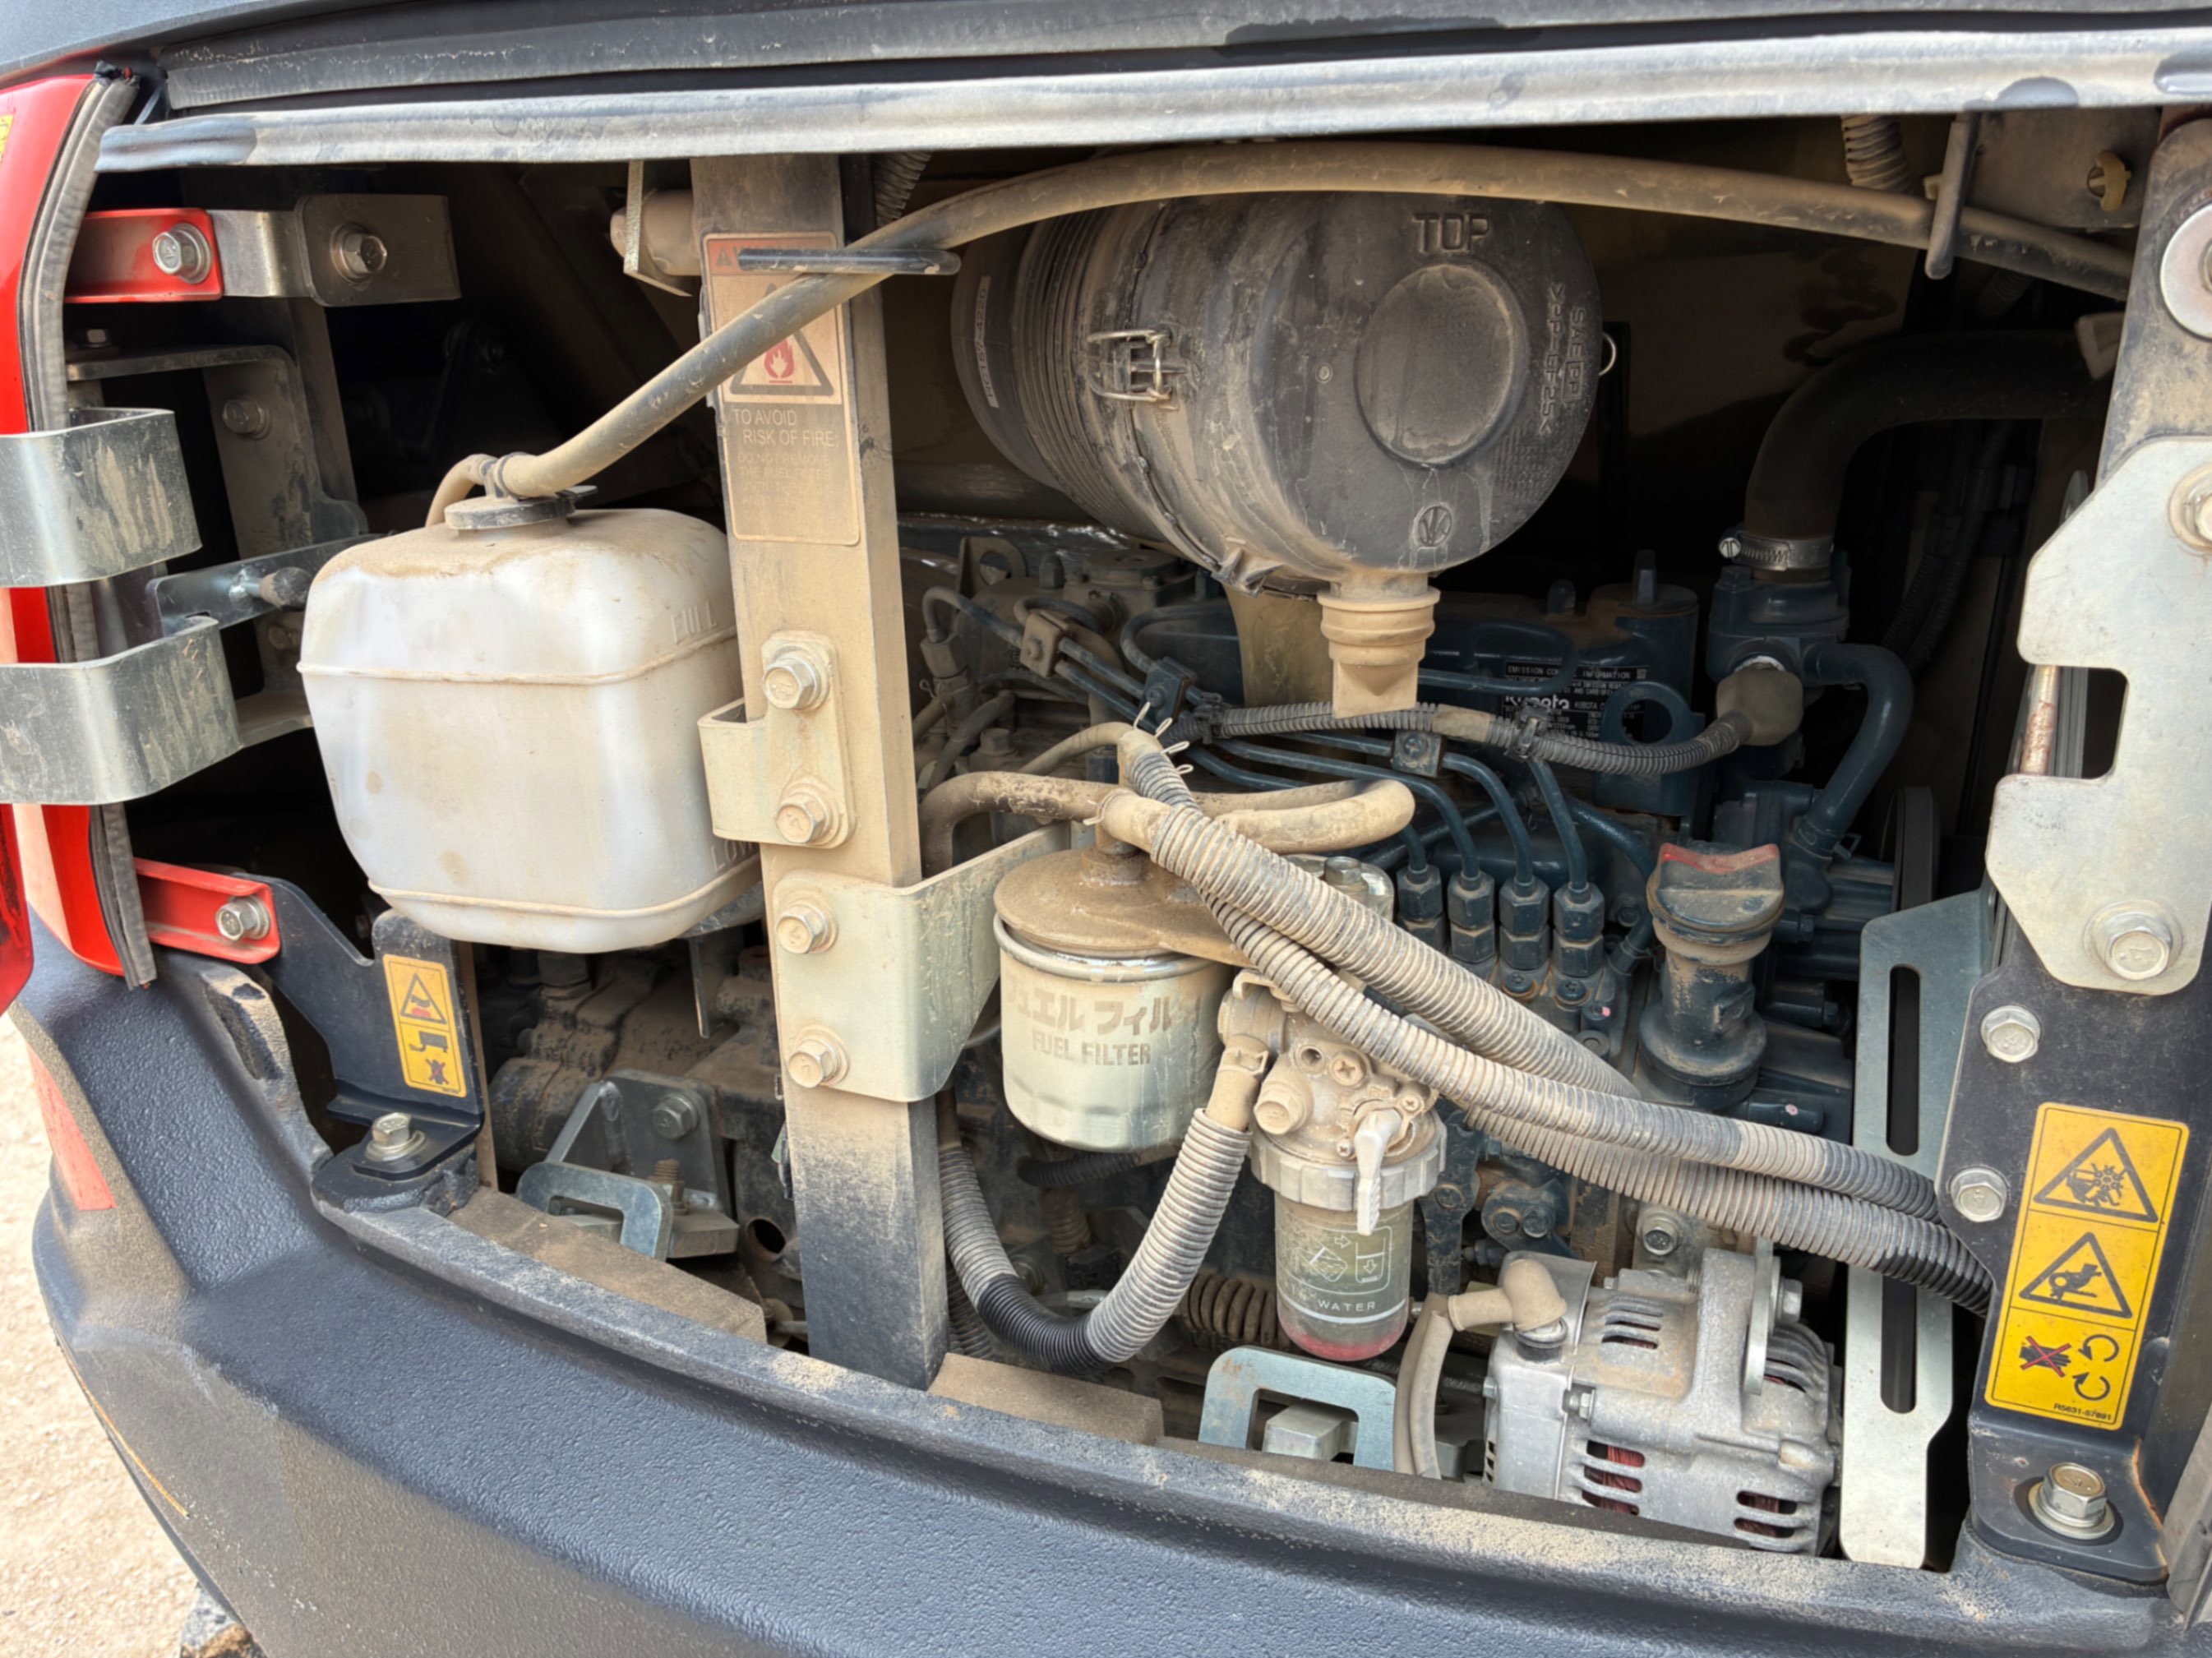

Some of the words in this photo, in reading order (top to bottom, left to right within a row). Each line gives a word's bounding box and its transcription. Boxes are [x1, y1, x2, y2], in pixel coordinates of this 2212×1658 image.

[1411, 212, 1489, 252] TOP
[732, 409, 751, 425] TO
[755, 409, 797, 426] AVOID
[743, 429, 776, 446] RISK
[779, 430, 797, 446] OF
[1508, 665, 1544, 675] EMISSION
[1582, 670, 1631, 680] INFORMATION
[1505, 694, 1570, 712] Kota
[1575, 701, 1597, 709] KUBOTA
[1032, 1028, 1074, 1060] FUEL
[1082, 1041, 1151, 1066] FILTER
[1318, 1299, 1376, 1312] WATER
